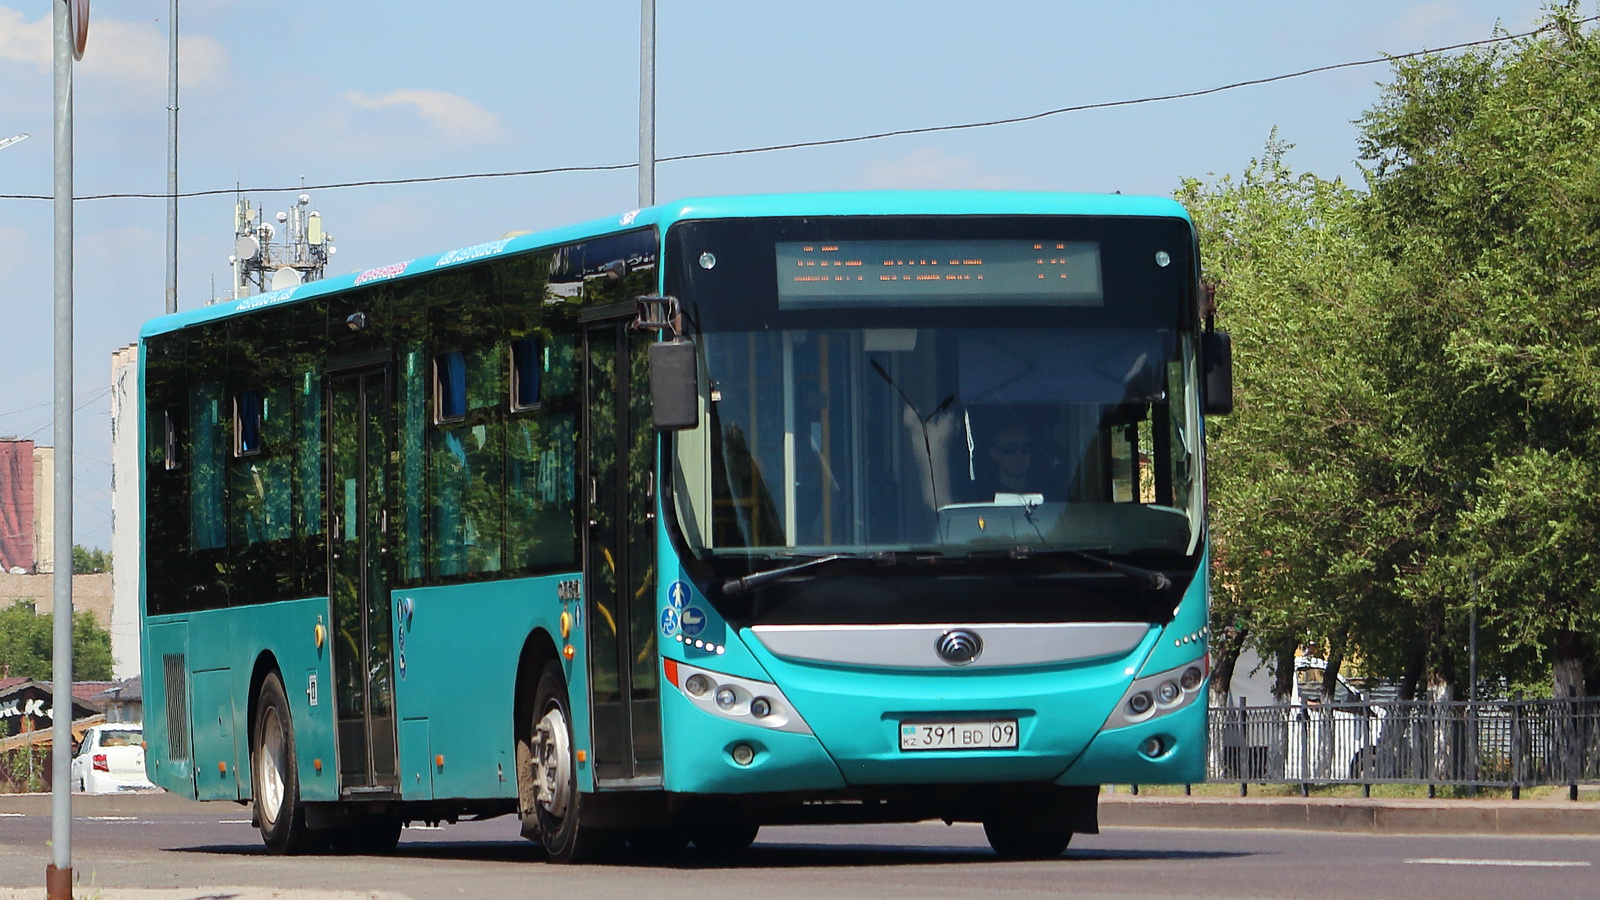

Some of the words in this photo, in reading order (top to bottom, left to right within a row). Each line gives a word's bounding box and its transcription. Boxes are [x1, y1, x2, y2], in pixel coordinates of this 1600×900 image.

[903, 738, 917, 746] KZ
[922, 726, 956, 745] 391
[962, 731, 984, 744] BD
[991, 725, 1014, 743] 09
